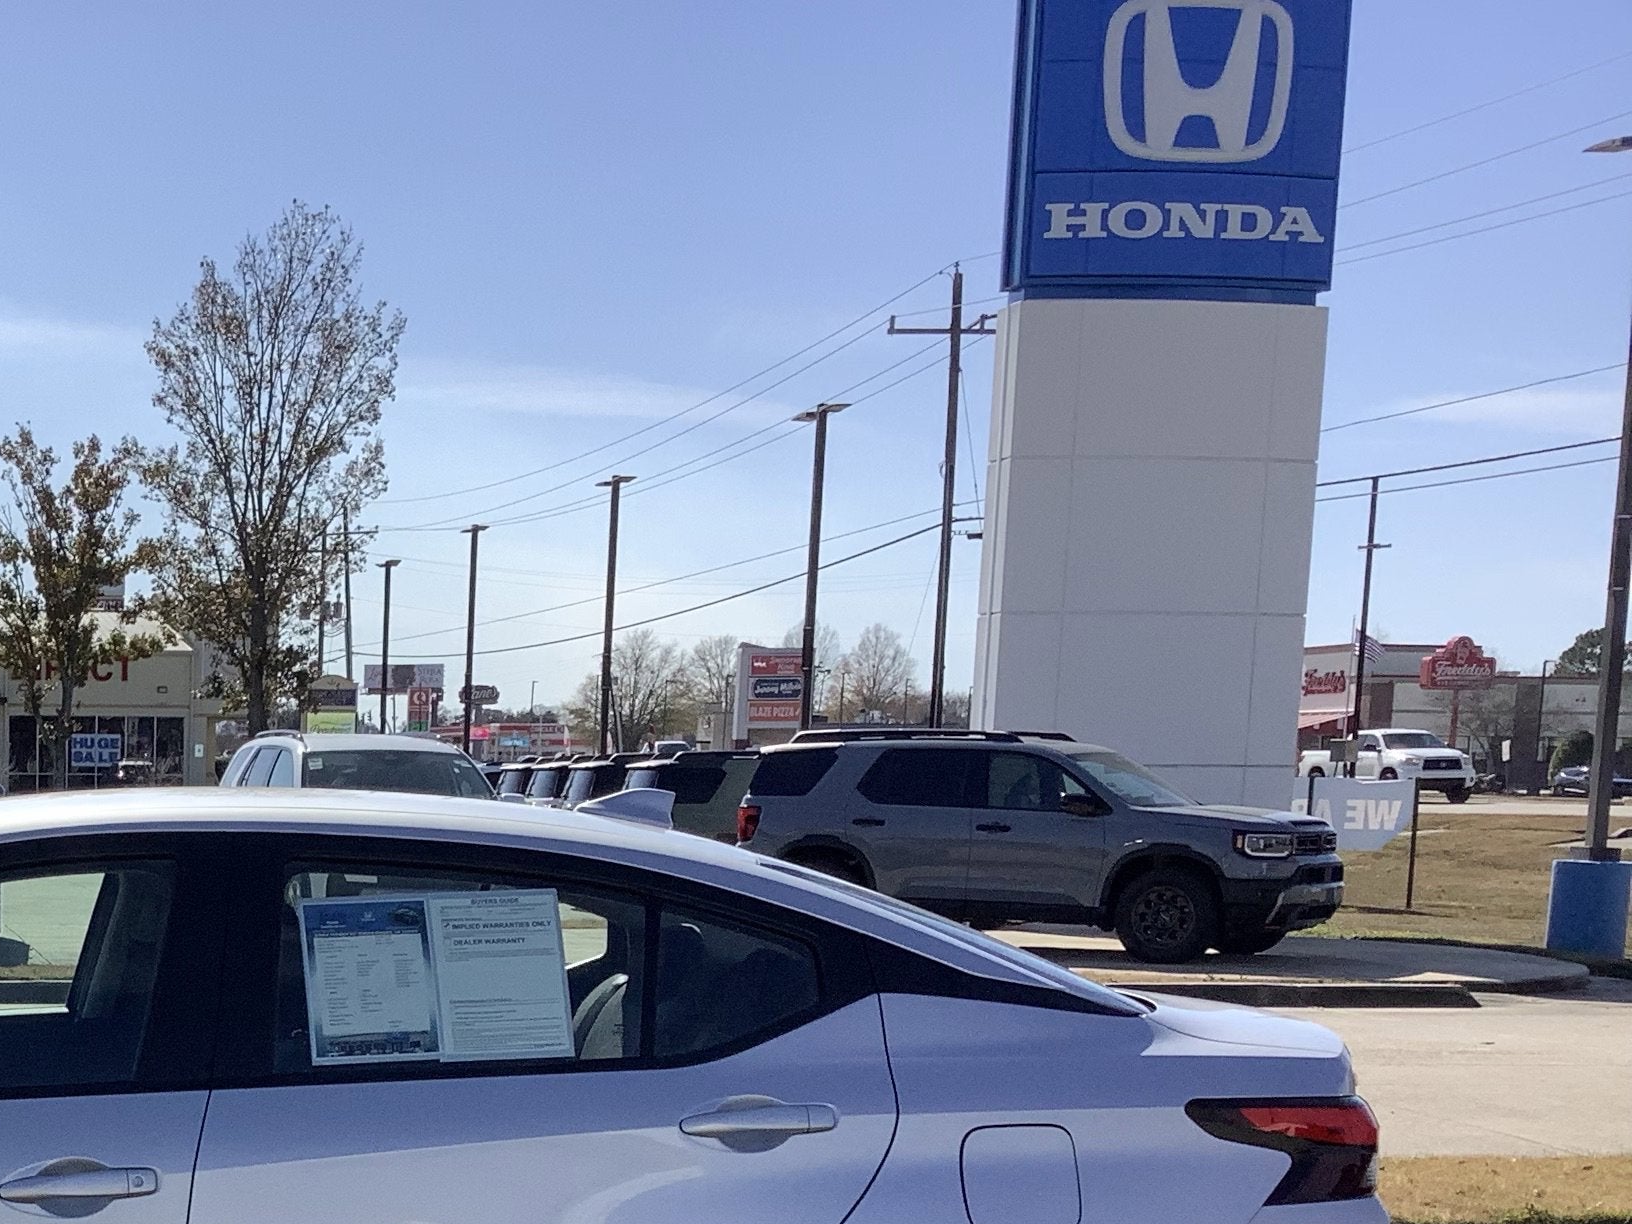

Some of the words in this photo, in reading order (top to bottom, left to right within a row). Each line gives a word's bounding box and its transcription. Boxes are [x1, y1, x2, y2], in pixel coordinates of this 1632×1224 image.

[1043, 201, 1325, 243] HONDA
[1432, 661, 1491, 677] Freddy's
[750, 707, 772, 716] BLAZE
[773, 706, 794, 716] PIZZA
[73, 737, 119, 749] HUGE
